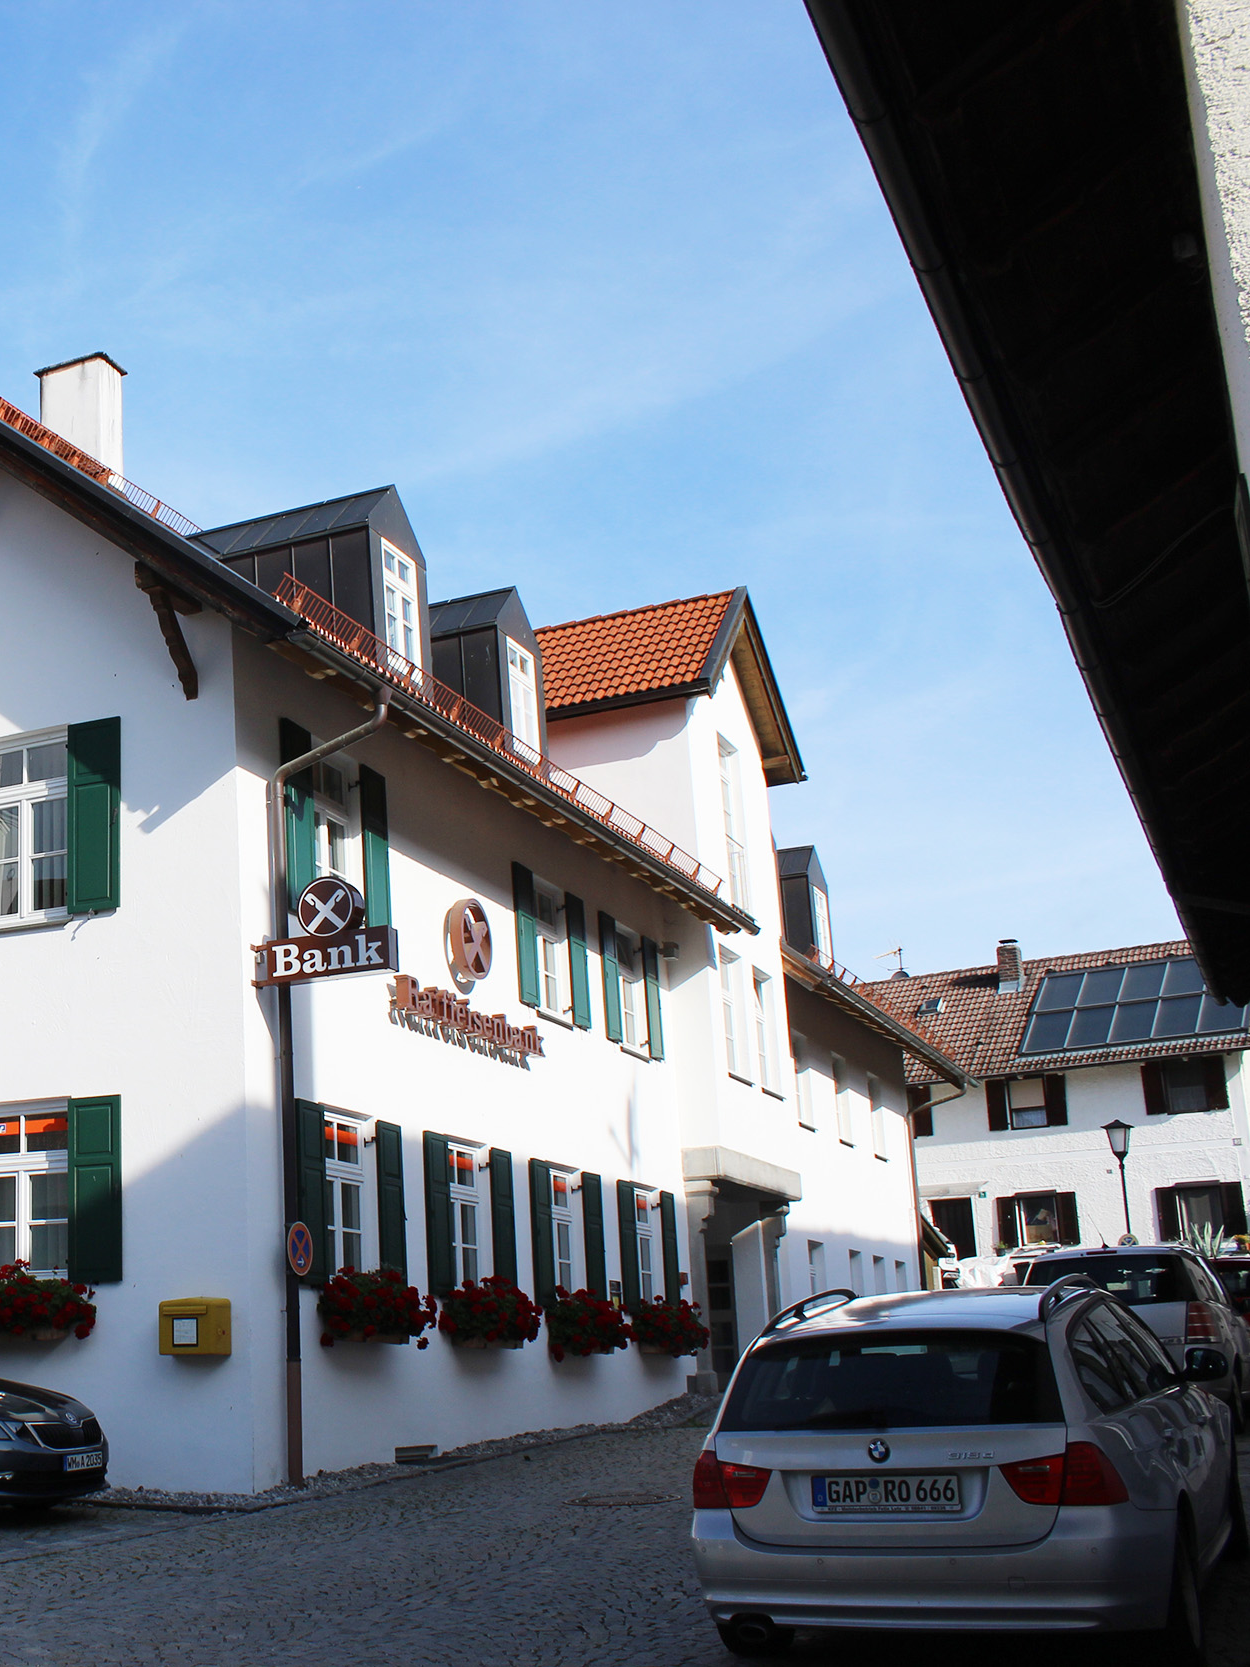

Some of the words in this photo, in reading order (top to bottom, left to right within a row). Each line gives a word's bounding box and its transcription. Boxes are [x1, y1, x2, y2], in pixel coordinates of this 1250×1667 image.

[272, 934, 384, 977] Bank
[827, 1480, 867, 1503] GAP
[883, 1479, 911, 1503] RO
[915, 1479, 955, 1502] 666
